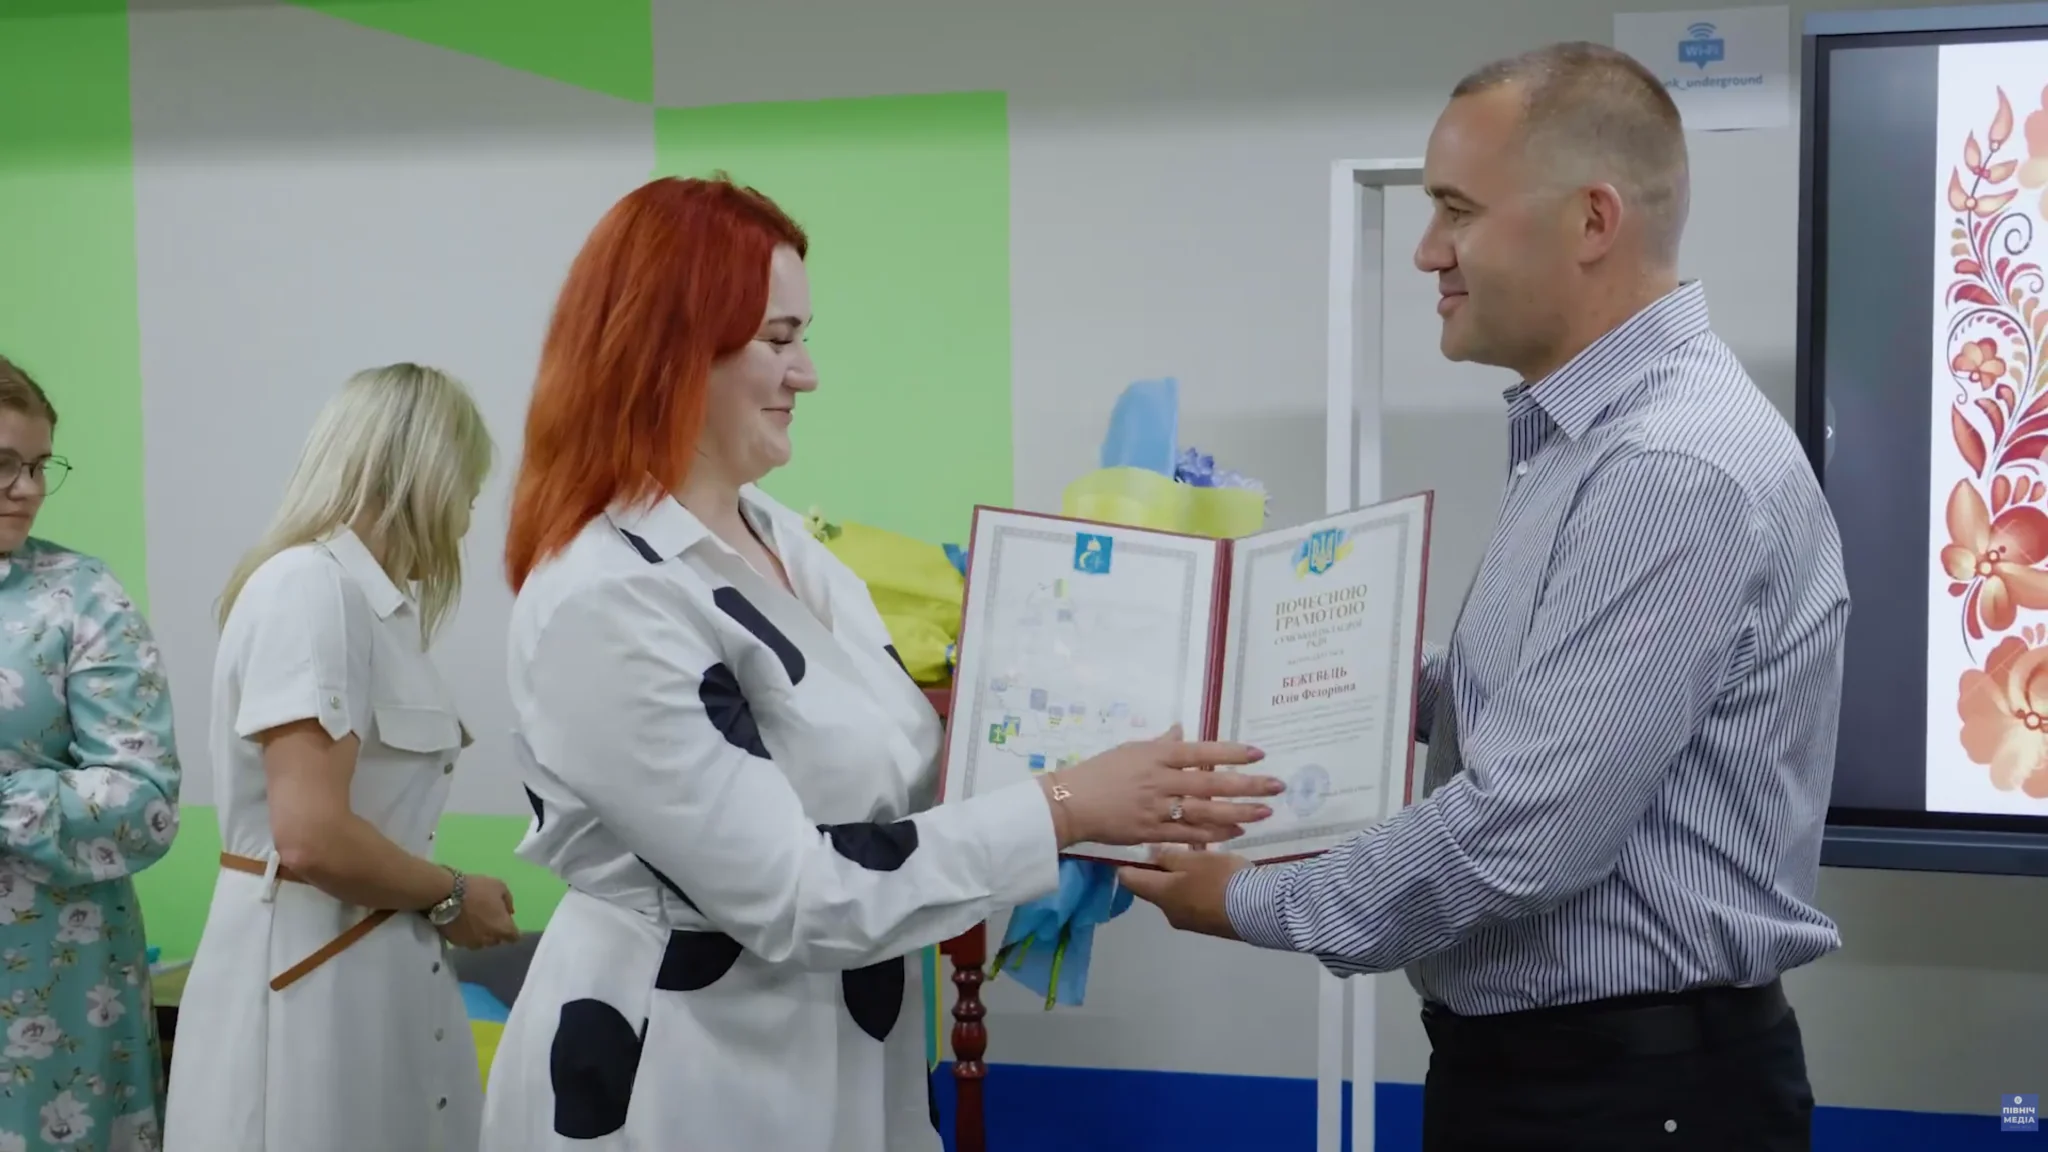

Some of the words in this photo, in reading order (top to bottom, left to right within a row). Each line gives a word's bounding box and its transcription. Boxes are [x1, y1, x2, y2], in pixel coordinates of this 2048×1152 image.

[1685, 44, 1720, 57] Wi-Fi
[1275, 584, 1368, 616] ПОЧЕСНОЮ
[1275, 601, 1366, 632] ГРАМОТОЮ
